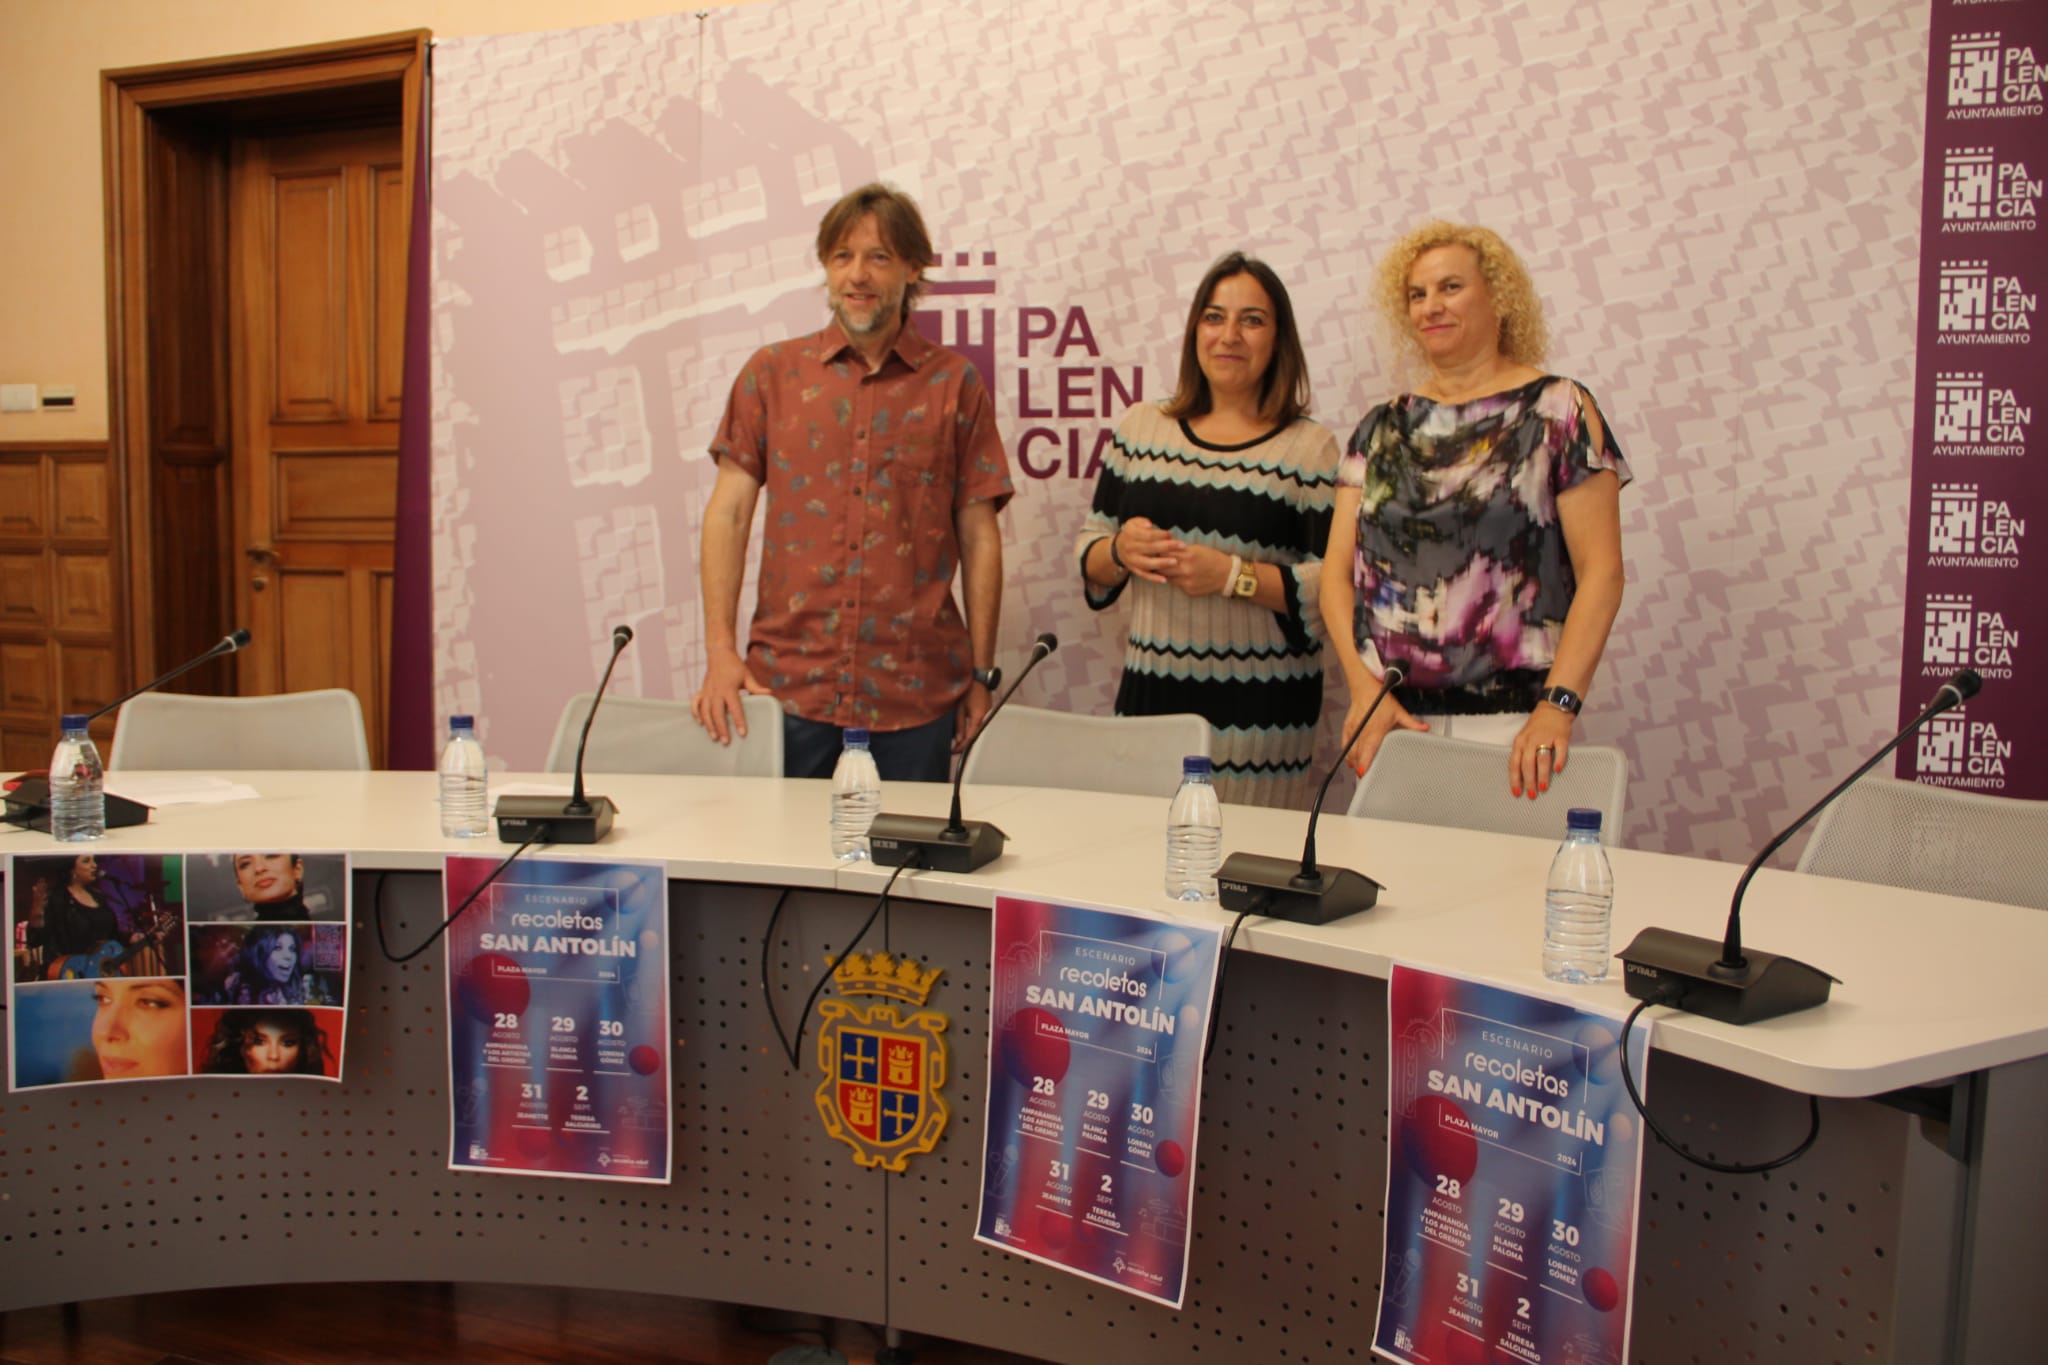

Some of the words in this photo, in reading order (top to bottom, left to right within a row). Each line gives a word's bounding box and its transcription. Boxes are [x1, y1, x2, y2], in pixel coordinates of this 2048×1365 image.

[2006, 48, 2035, 65] PA
[2004, 63, 2048, 84] LEN
[2003, 84, 2043, 103] CIA
[1947, 105, 2043, 120] AYUNTAMIENTO
[1999, 162, 2028, 180] PA
[1998, 180, 2042, 199] LEN
[1996, 199, 2036, 218] CIA
[1942, 220, 2036, 233] AYUNTAMIENTO
[1993, 277, 2022, 293] PA
[1992, 294, 2036, 312] LEN
[1991, 312, 2030, 331] CIA
[1018, 305, 1100, 358] PA
[1937, 333, 2031, 345] AYUNTAMIENTO
[1018, 366, 1143, 418] LEN
[1988, 389, 2016, 406] PA
[1987, 407, 2031, 425] LEN
[1986, 425, 2025, 443] CIA
[1933, 445, 2025, 456] AYUNTAMIENTO
[1983, 501, 2011, 518] PA
[1982, 519, 2025, 536] LEN
[1980, 537, 2019, 555] CIA
[1928, 557, 2019, 568] AYUNTAMIENTO
[1978, 612, 2004, 629] PA
[1977, 630, 2018, 648] LEN
[1974, 648, 2012, 665] CIA
[1921, 666, 2013, 679] AYUNIENTO
[1970, 723, 1997, 739] PA
[1969, 741, 2011, 758] LEN
[1968, 758, 2005, 775] CIA
[1916, 775, 2005, 789] AYUNTAMIENTO
[524, 894, 587, 905] ESCENARIO
[511, 910, 603, 930] recoletas
[480, 933, 529, 952] SAN
[533, 936, 636, 958] ANTOLÍN
[1075, 946, 1136, 966] ESCENARIO
[1060, 966, 1147, 998] recoletas
[1026, 985, 1075, 1011] SAN
[1078, 995, 1175, 1036] ANTOLÍN
[494, 1012, 518, 1029] 28
[551, 1016, 575, 1032] 29
[599, 1020, 623, 1037] 30
[1041, 1023, 1063, 1034] PLAZA
[1064, 1028, 1089, 1040] MAYOR
[1482, 1030, 1553, 1059] ESCENARIO
[1465, 1052, 1569, 1098] recoletas
[521, 1083, 542, 1099] 31
[576, 1085, 589, 1101] 2
[1032, 1076, 1055, 1096] 28
[1029, 1096, 1056, 1109] AGOSTO
[1087, 1090, 1109, 1110] 29
[1427, 1069, 1482, 1105] SAN
[1485, 1088, 1604, 1146] ANTOLÍN
[1083, 1110, 1110, 1124] AGOSTO
[1131, 1103, 1153, 1124] 30
[1128, 1124, 1154, 1138] AGOSTO
[1444, 1114, 1470, 1129] PLAZA
[1471, 1123, 1499, 1139] MAYOR
[1557, 1153, 1577, 1167] 2024
[1049, 1159, 1070, 1181] 31
[1046, 1180, 1072, 1194] AGOSTO
[1100, 1174, 1113, 1193] 2
[1435, 1174, 1460, 1199] 28
[1432, 1196, 1462, 1214] AGOSTO
[1498, 1198, 1525, 1223] 29
[1424, 1226, 1437, 1237] DEL
[1438, 1231, 1465, 1248] GREMIO
[1425, 1217, 1438, 1228] LOS
[1439, 1222, 1471, 1241] ARTISTAS
[1493, 1221, 1526, 1240] AGOSTO
[1551, 1219, 1580, 1247] 30
[1494, 1235, 1524, 1253] BLANCA
[1548, 1243, 1581, 1263] AGOSTO
[1492, 1244, 1523, 1263] PALOMA
[1548, 1258, 1578, 1277] LORENA
[1456, 1272, 1479, 1299] 31
[1549, 1268, 1576, 1286] GÓMEZ
[1453, 1295, 1483, 1313] AGOSTO
[1516, 1297, 1530, 1319] 2
[1448, 1306, 1483, 1328] JEANETTE
[1500, 1338, 1541, 1362] SALGUEIRO
[1507, 1332, 1535, 1350] TERESA
